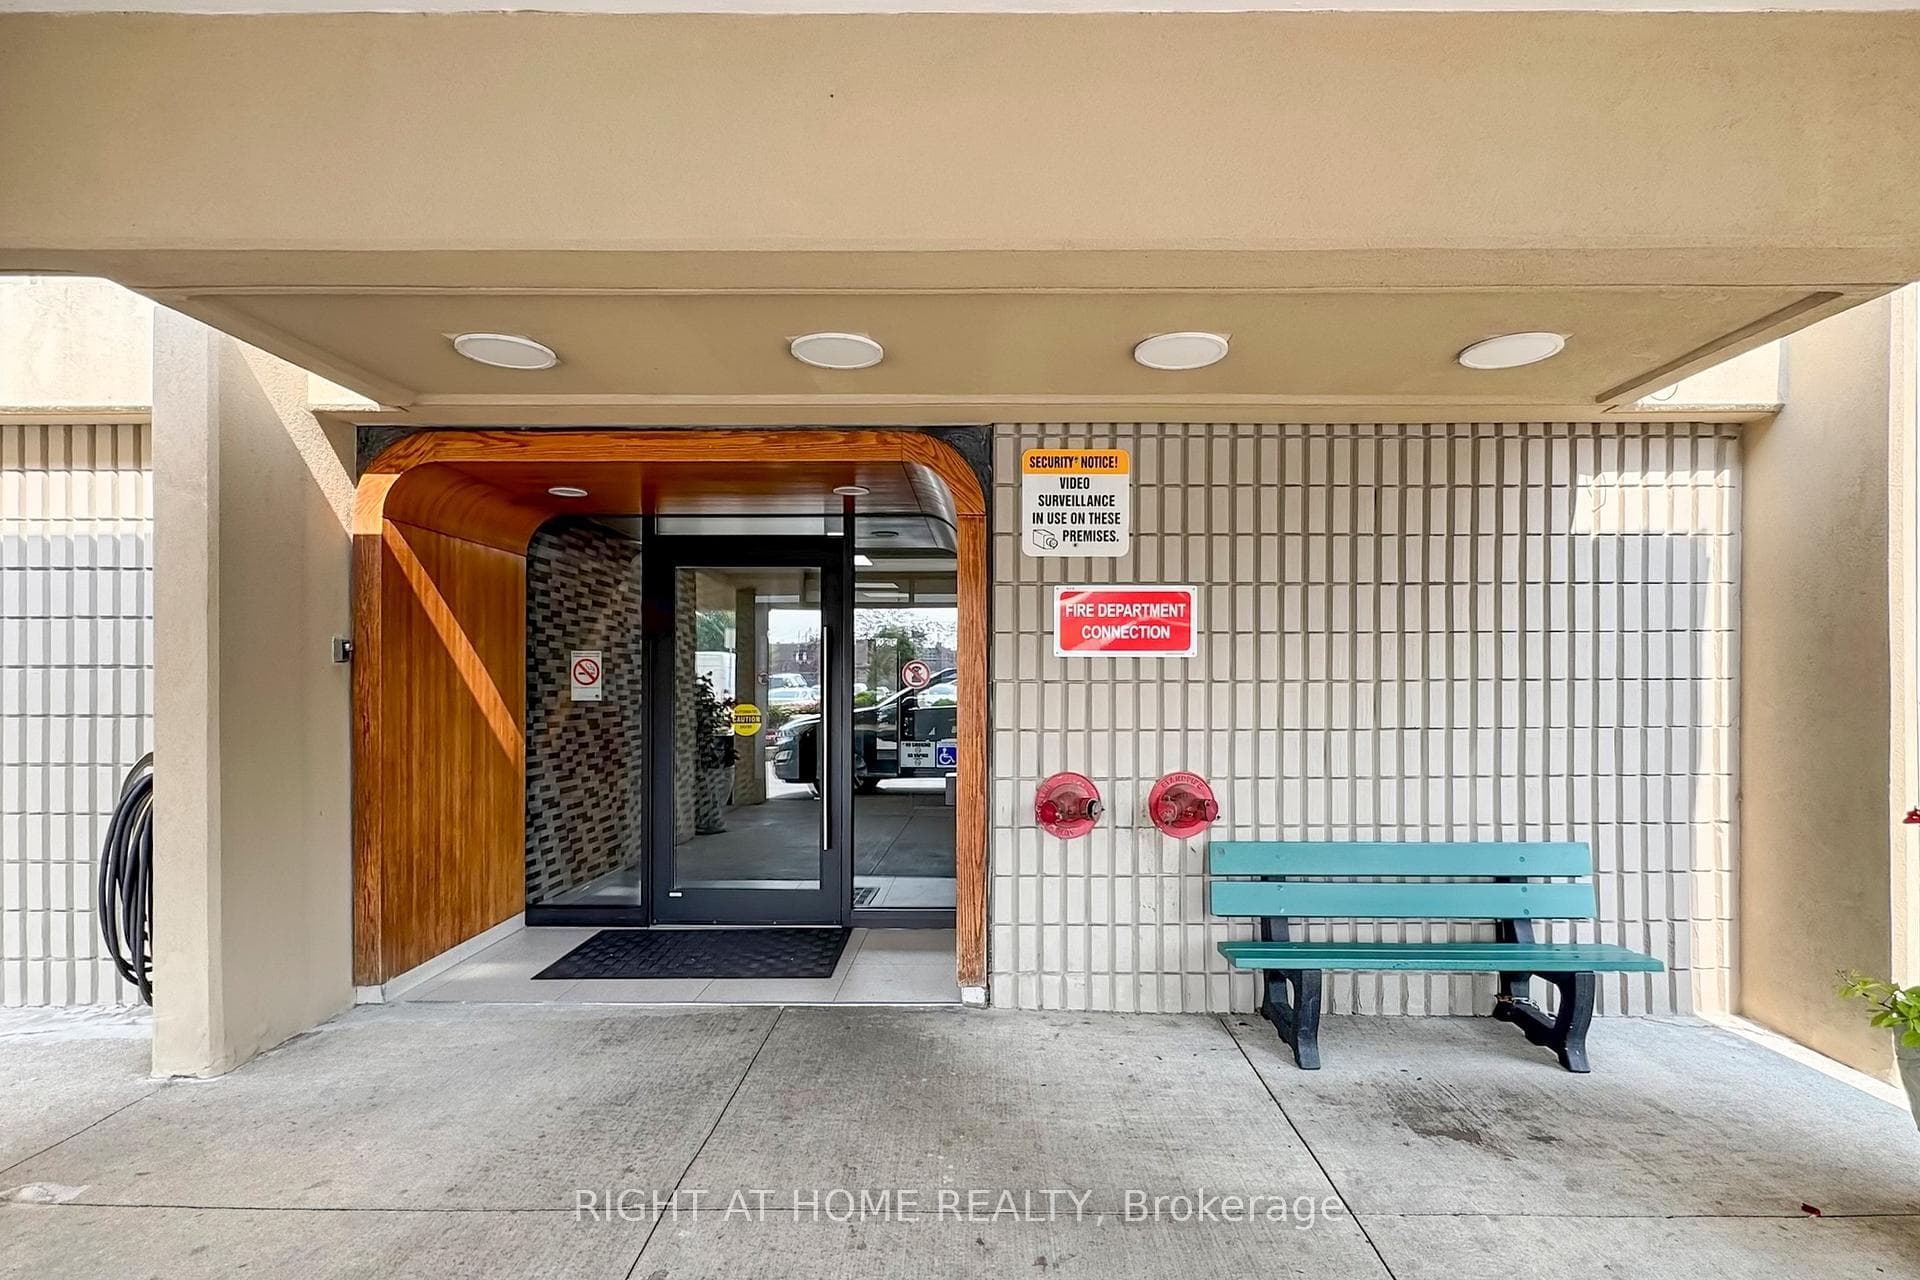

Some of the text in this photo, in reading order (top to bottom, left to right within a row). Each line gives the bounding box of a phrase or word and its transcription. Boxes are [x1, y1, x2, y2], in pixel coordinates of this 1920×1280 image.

[1029, 456, 1118, 468] SECURITY NOTICE!
[1059, 477, 1090, 489] VIDEO
[1038, 495, 1115, 507] SURVEILLANCE
[1032, 513, 1121, 524] IN USE ON THESE
[1062, 530, 1119, 542] PREMISES.
[1065, 603, 1186, 617] FIRE DEPARTMENT
[1081, 625, 1171, 639] CONNECTION
